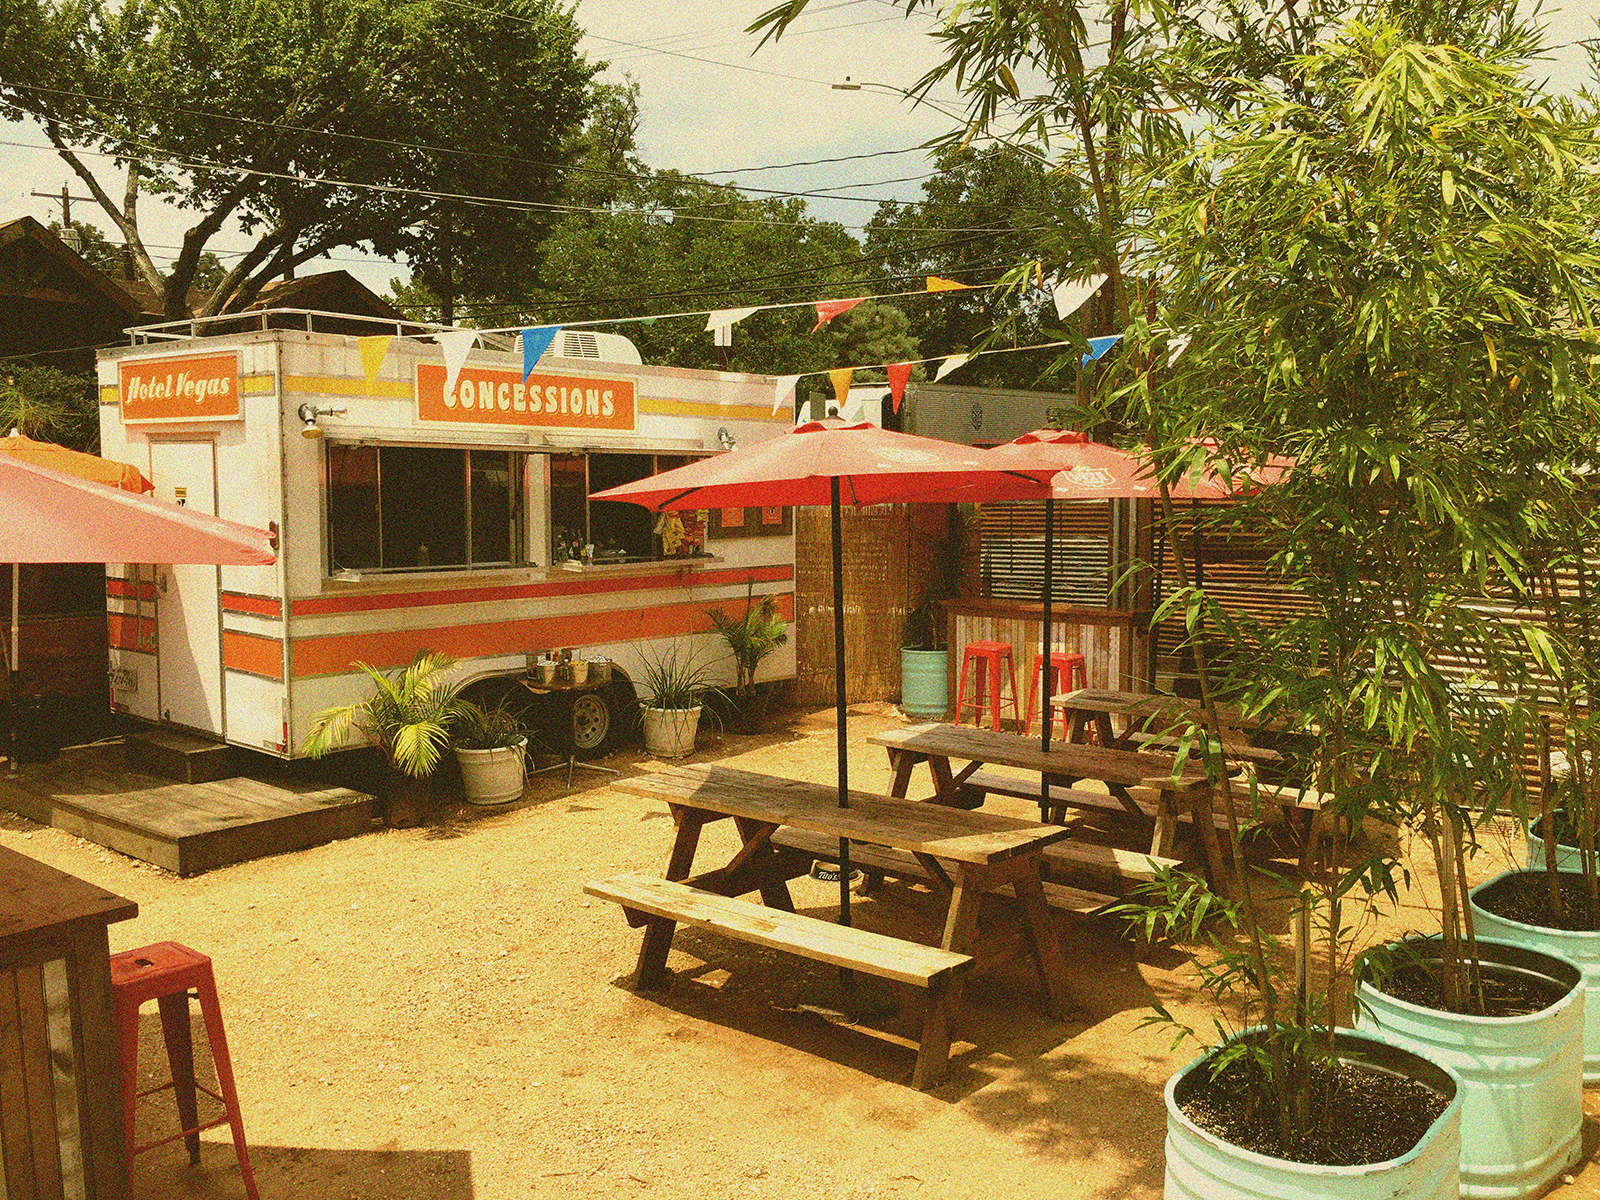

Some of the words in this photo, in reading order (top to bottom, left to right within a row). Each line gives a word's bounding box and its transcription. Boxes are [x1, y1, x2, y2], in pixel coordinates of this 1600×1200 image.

[124, 374, 174, 404] Hotel
[175, 371, 231, 403] Vegas
[818, 871, 838, 881] Tito's
